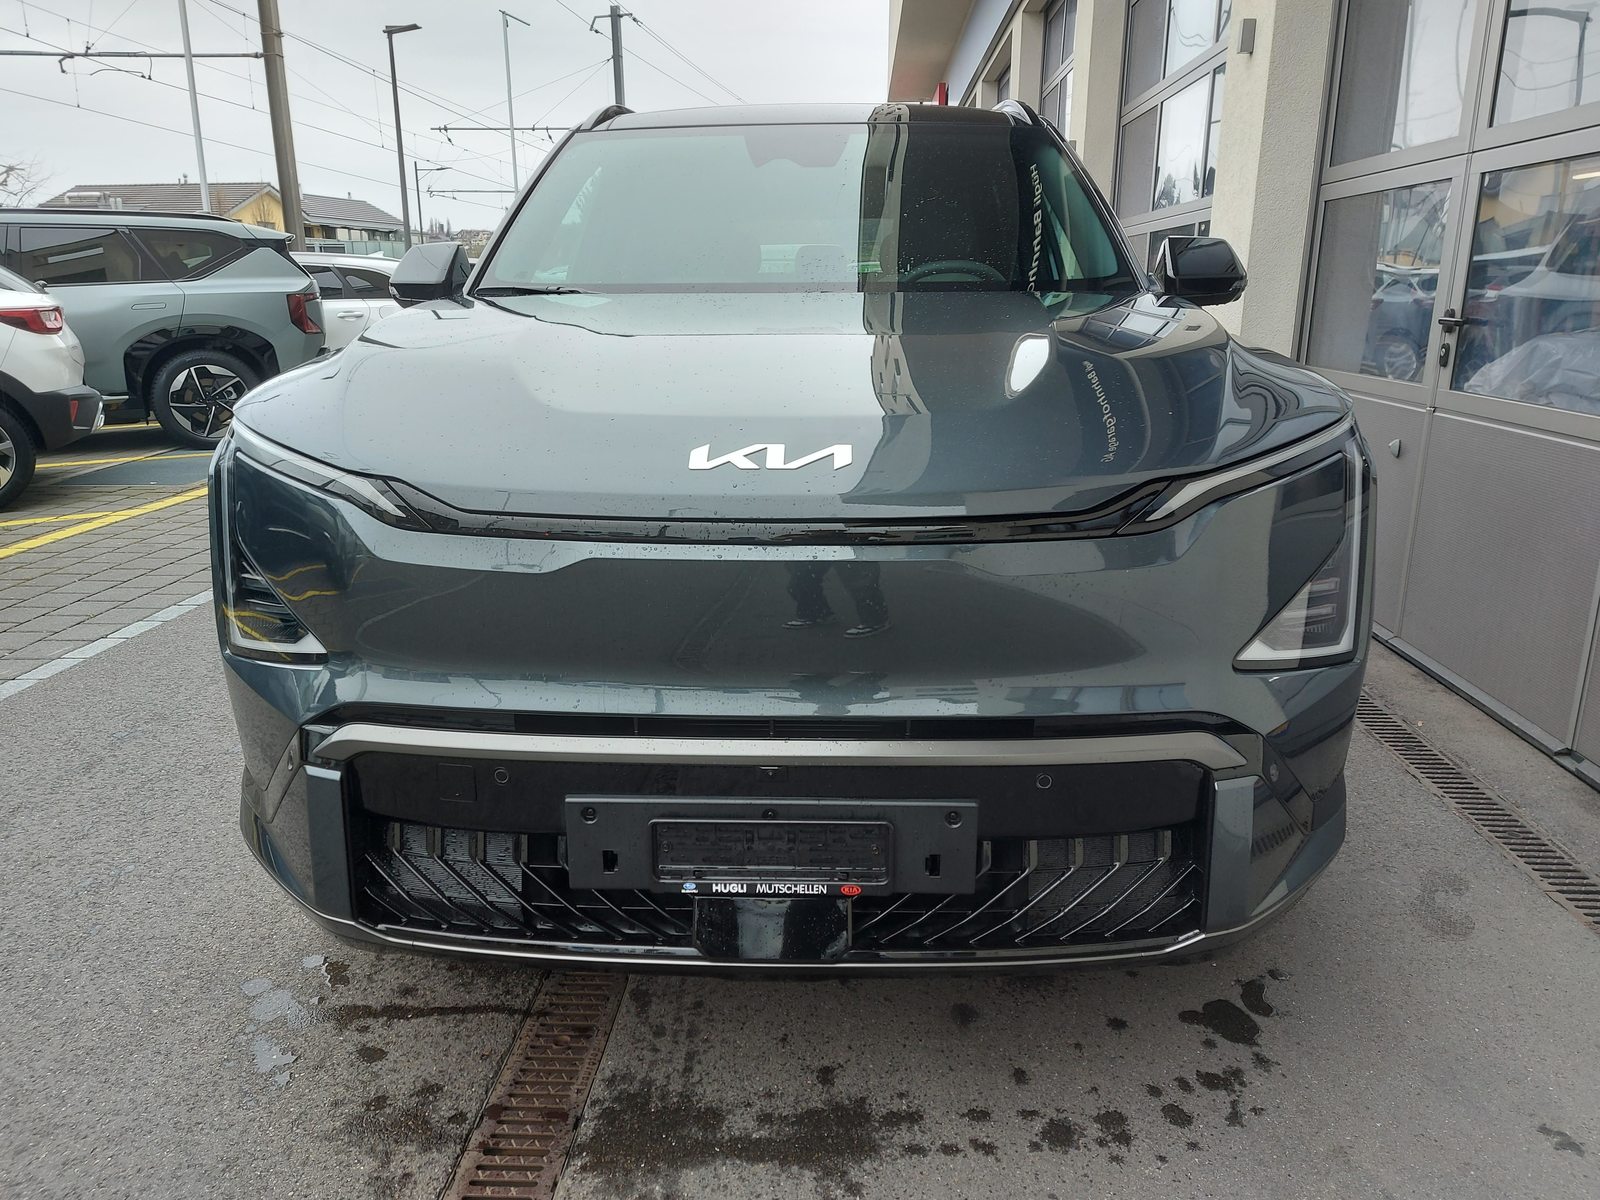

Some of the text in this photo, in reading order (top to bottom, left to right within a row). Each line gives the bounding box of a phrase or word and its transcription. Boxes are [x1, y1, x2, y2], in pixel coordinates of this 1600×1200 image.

[688, 443, 852, 471] KIA
[756, 883, 827, 894] MUTSCHELLEN
[843, 886, 859, 894] KIA
